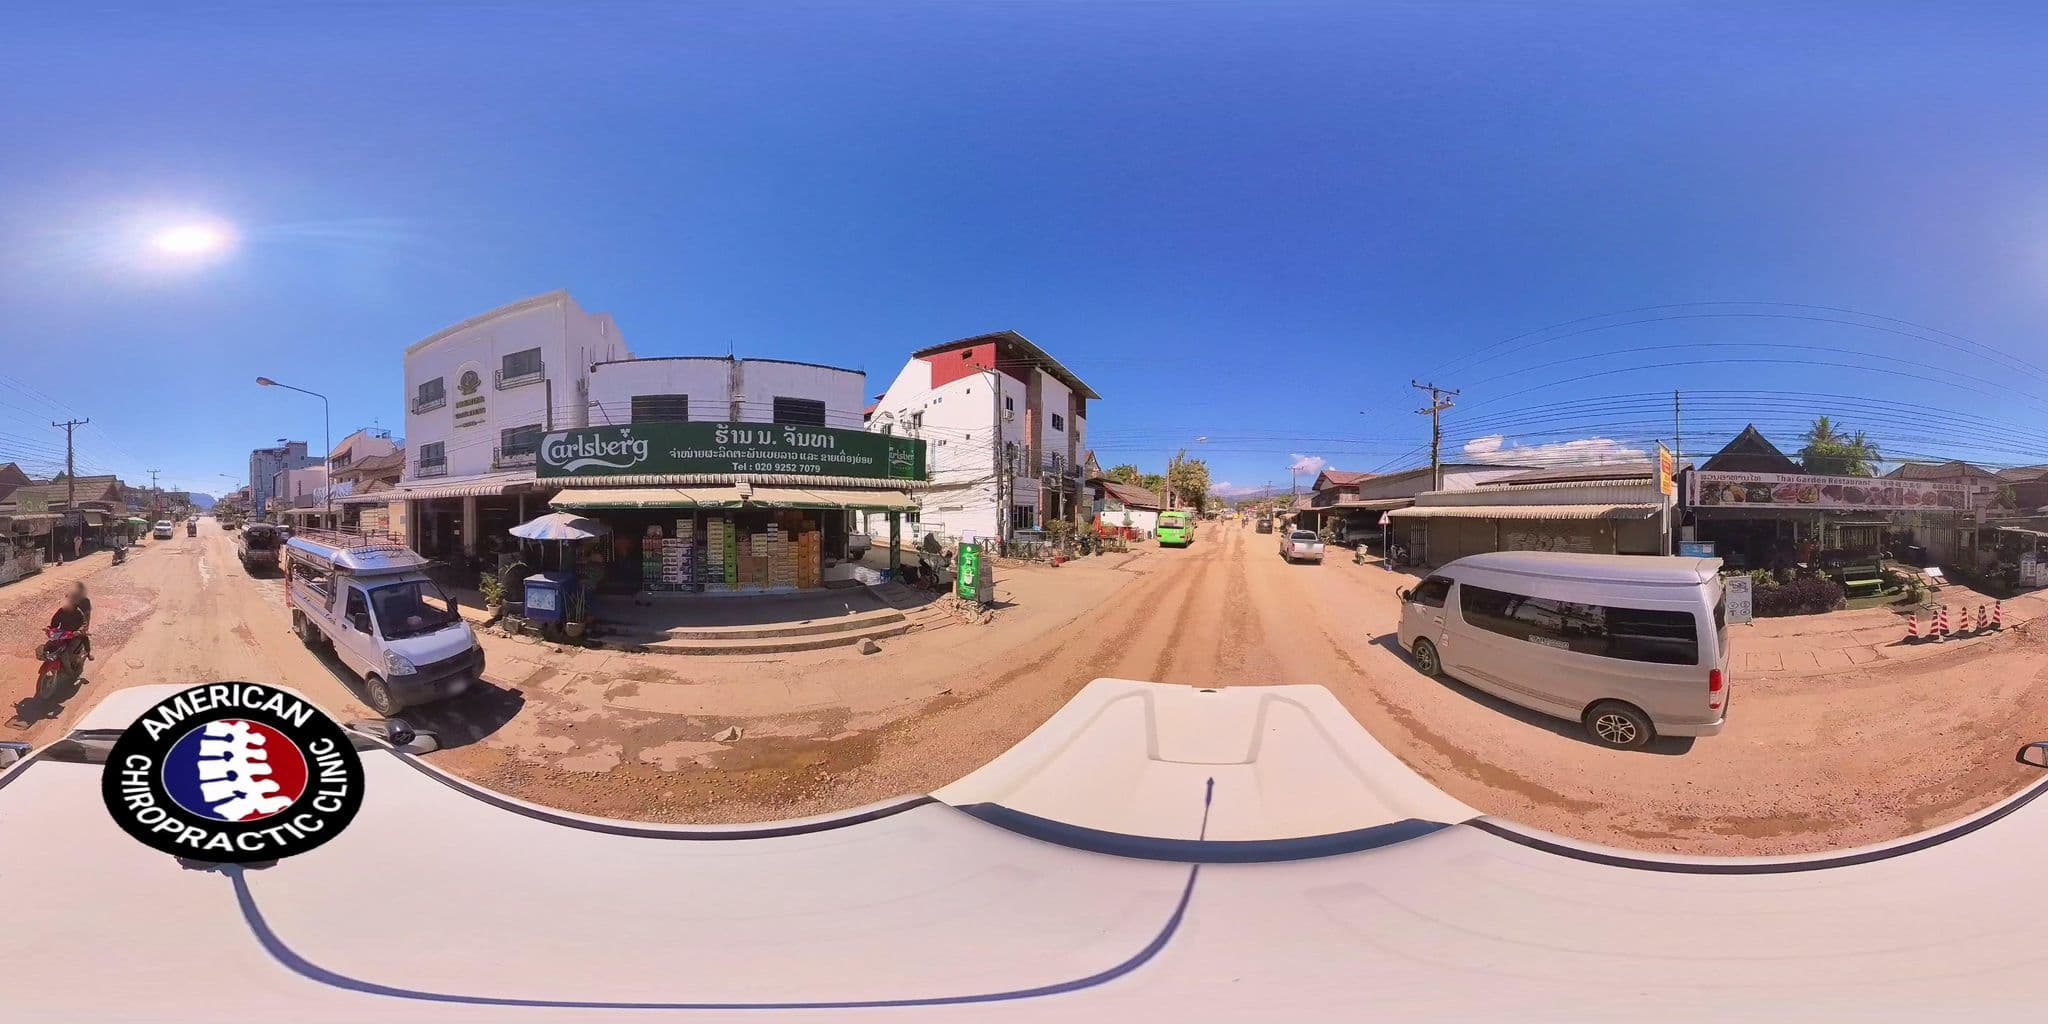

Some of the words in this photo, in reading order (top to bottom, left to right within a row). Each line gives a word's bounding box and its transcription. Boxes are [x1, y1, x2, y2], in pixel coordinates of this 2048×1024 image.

[541, 432, 649, 466] Carlsberg
[732, 462, 747, 471] Tel
[755, 463, 772, 471] 020
[774, 463, 797, 472] 9252
[799, 464, 821, 473] 7079
[1796, 476, 1827, 484] Garden
[1828, 478, 1871, 486] Restaurant
